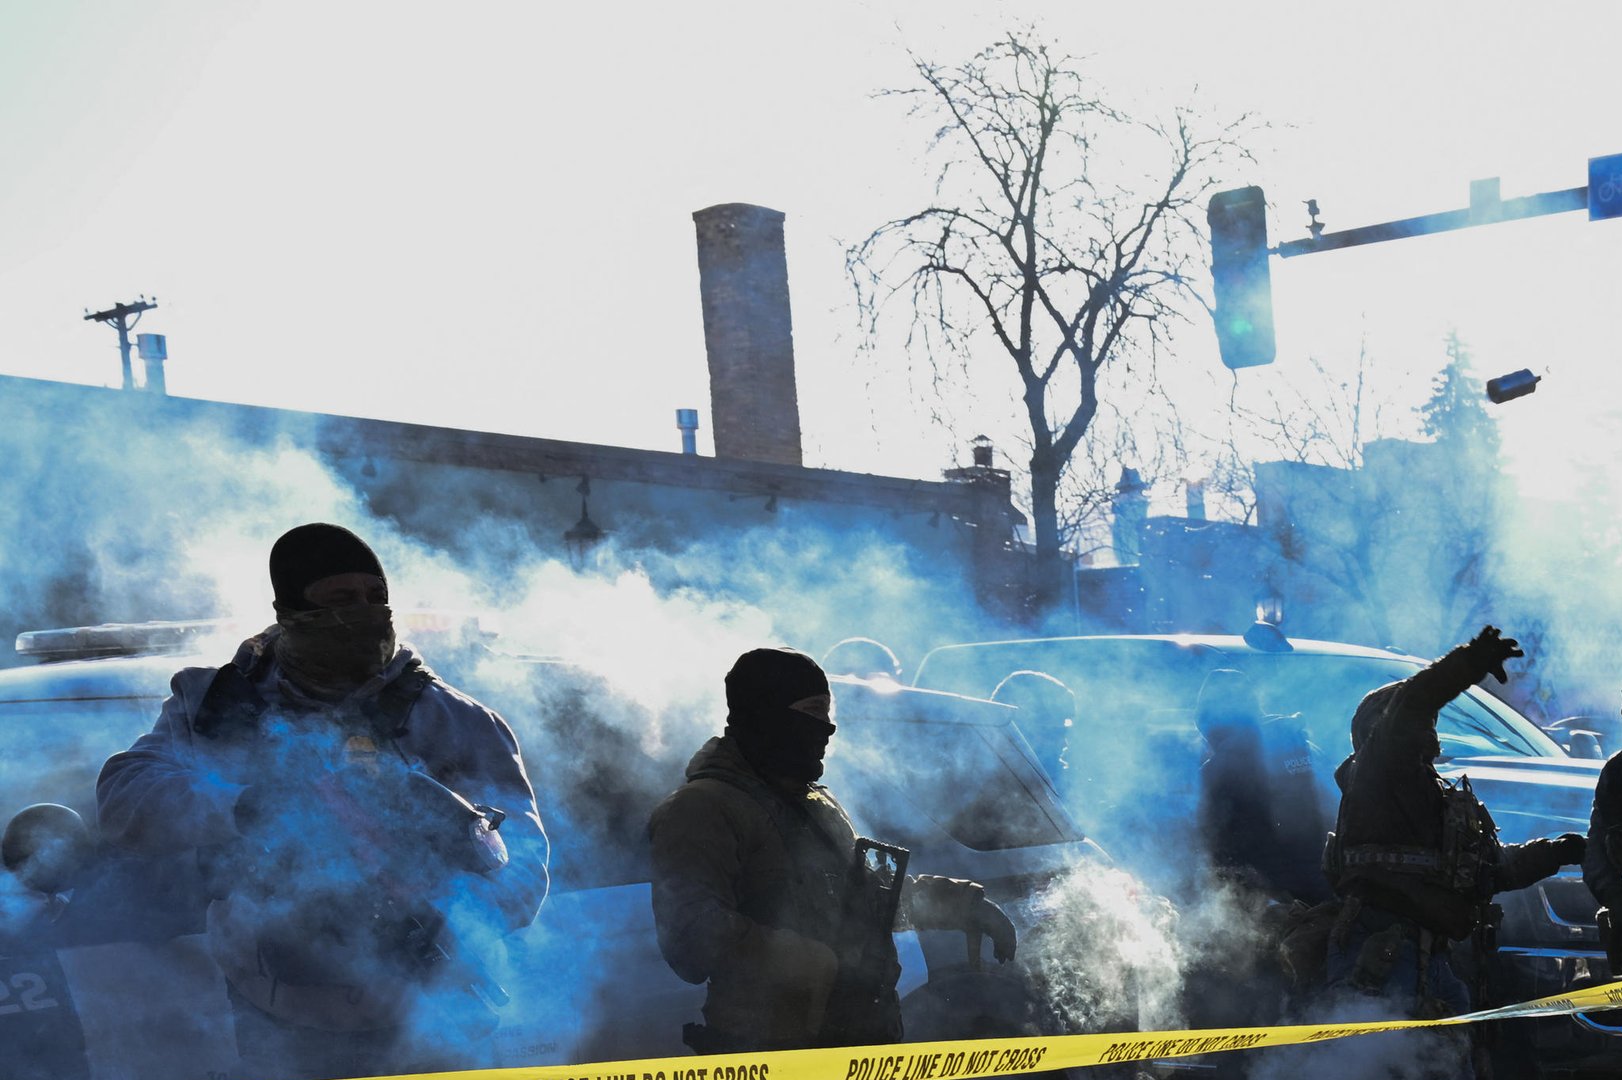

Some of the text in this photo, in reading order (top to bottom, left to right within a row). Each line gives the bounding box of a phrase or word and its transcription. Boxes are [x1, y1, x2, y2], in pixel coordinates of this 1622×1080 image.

[1284, 756, 1312, 770] POLICE
[937, 1051, 965, 1078] DO
[962, 1050, 999, 1076] NOT
[993, 1047, 1047, 1073] CROSS
[1098, 1041, 1154, 1063] POLICE
[1146, 1038, 1183, 1060] LINE
[1177, 1037, 1201, 1055] DO
[1195, 1035, 1229, 1053] NOT
